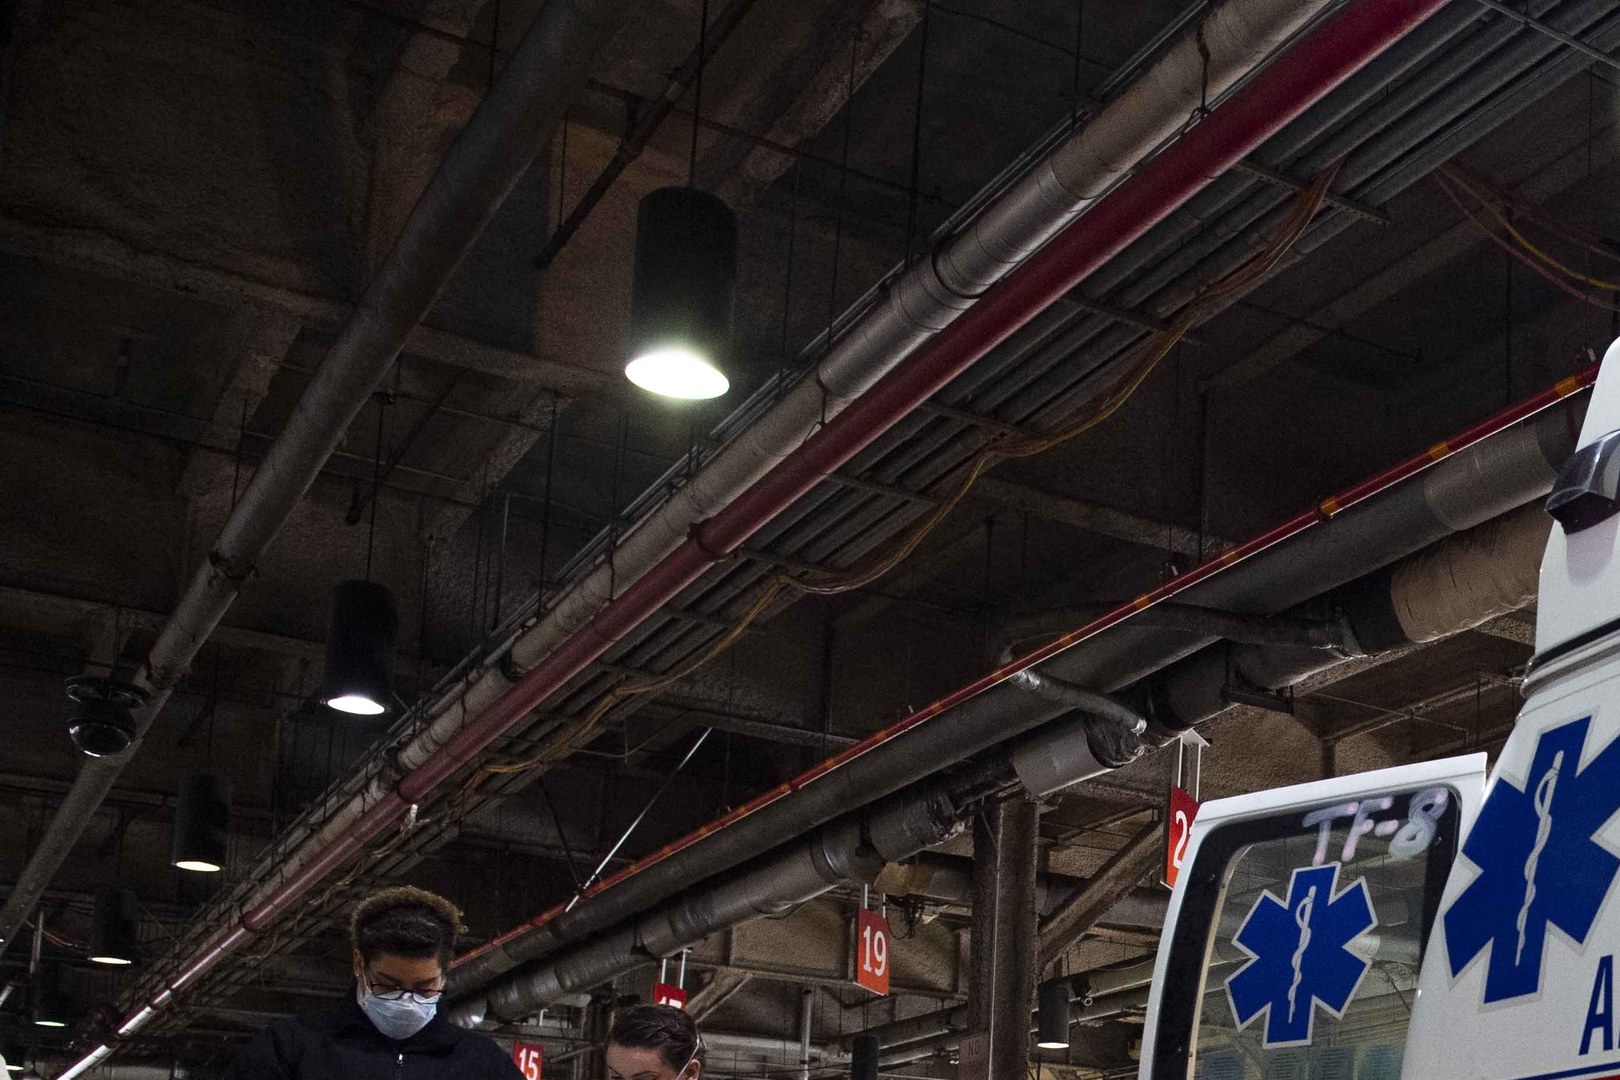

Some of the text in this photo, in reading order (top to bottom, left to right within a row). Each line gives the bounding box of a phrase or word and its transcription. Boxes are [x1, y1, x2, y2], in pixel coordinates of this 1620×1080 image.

[1172, 809, 1194, 870] 2
[1302, 787, 1450, 867] TF-8
[862, 925, 888, 978] 19
